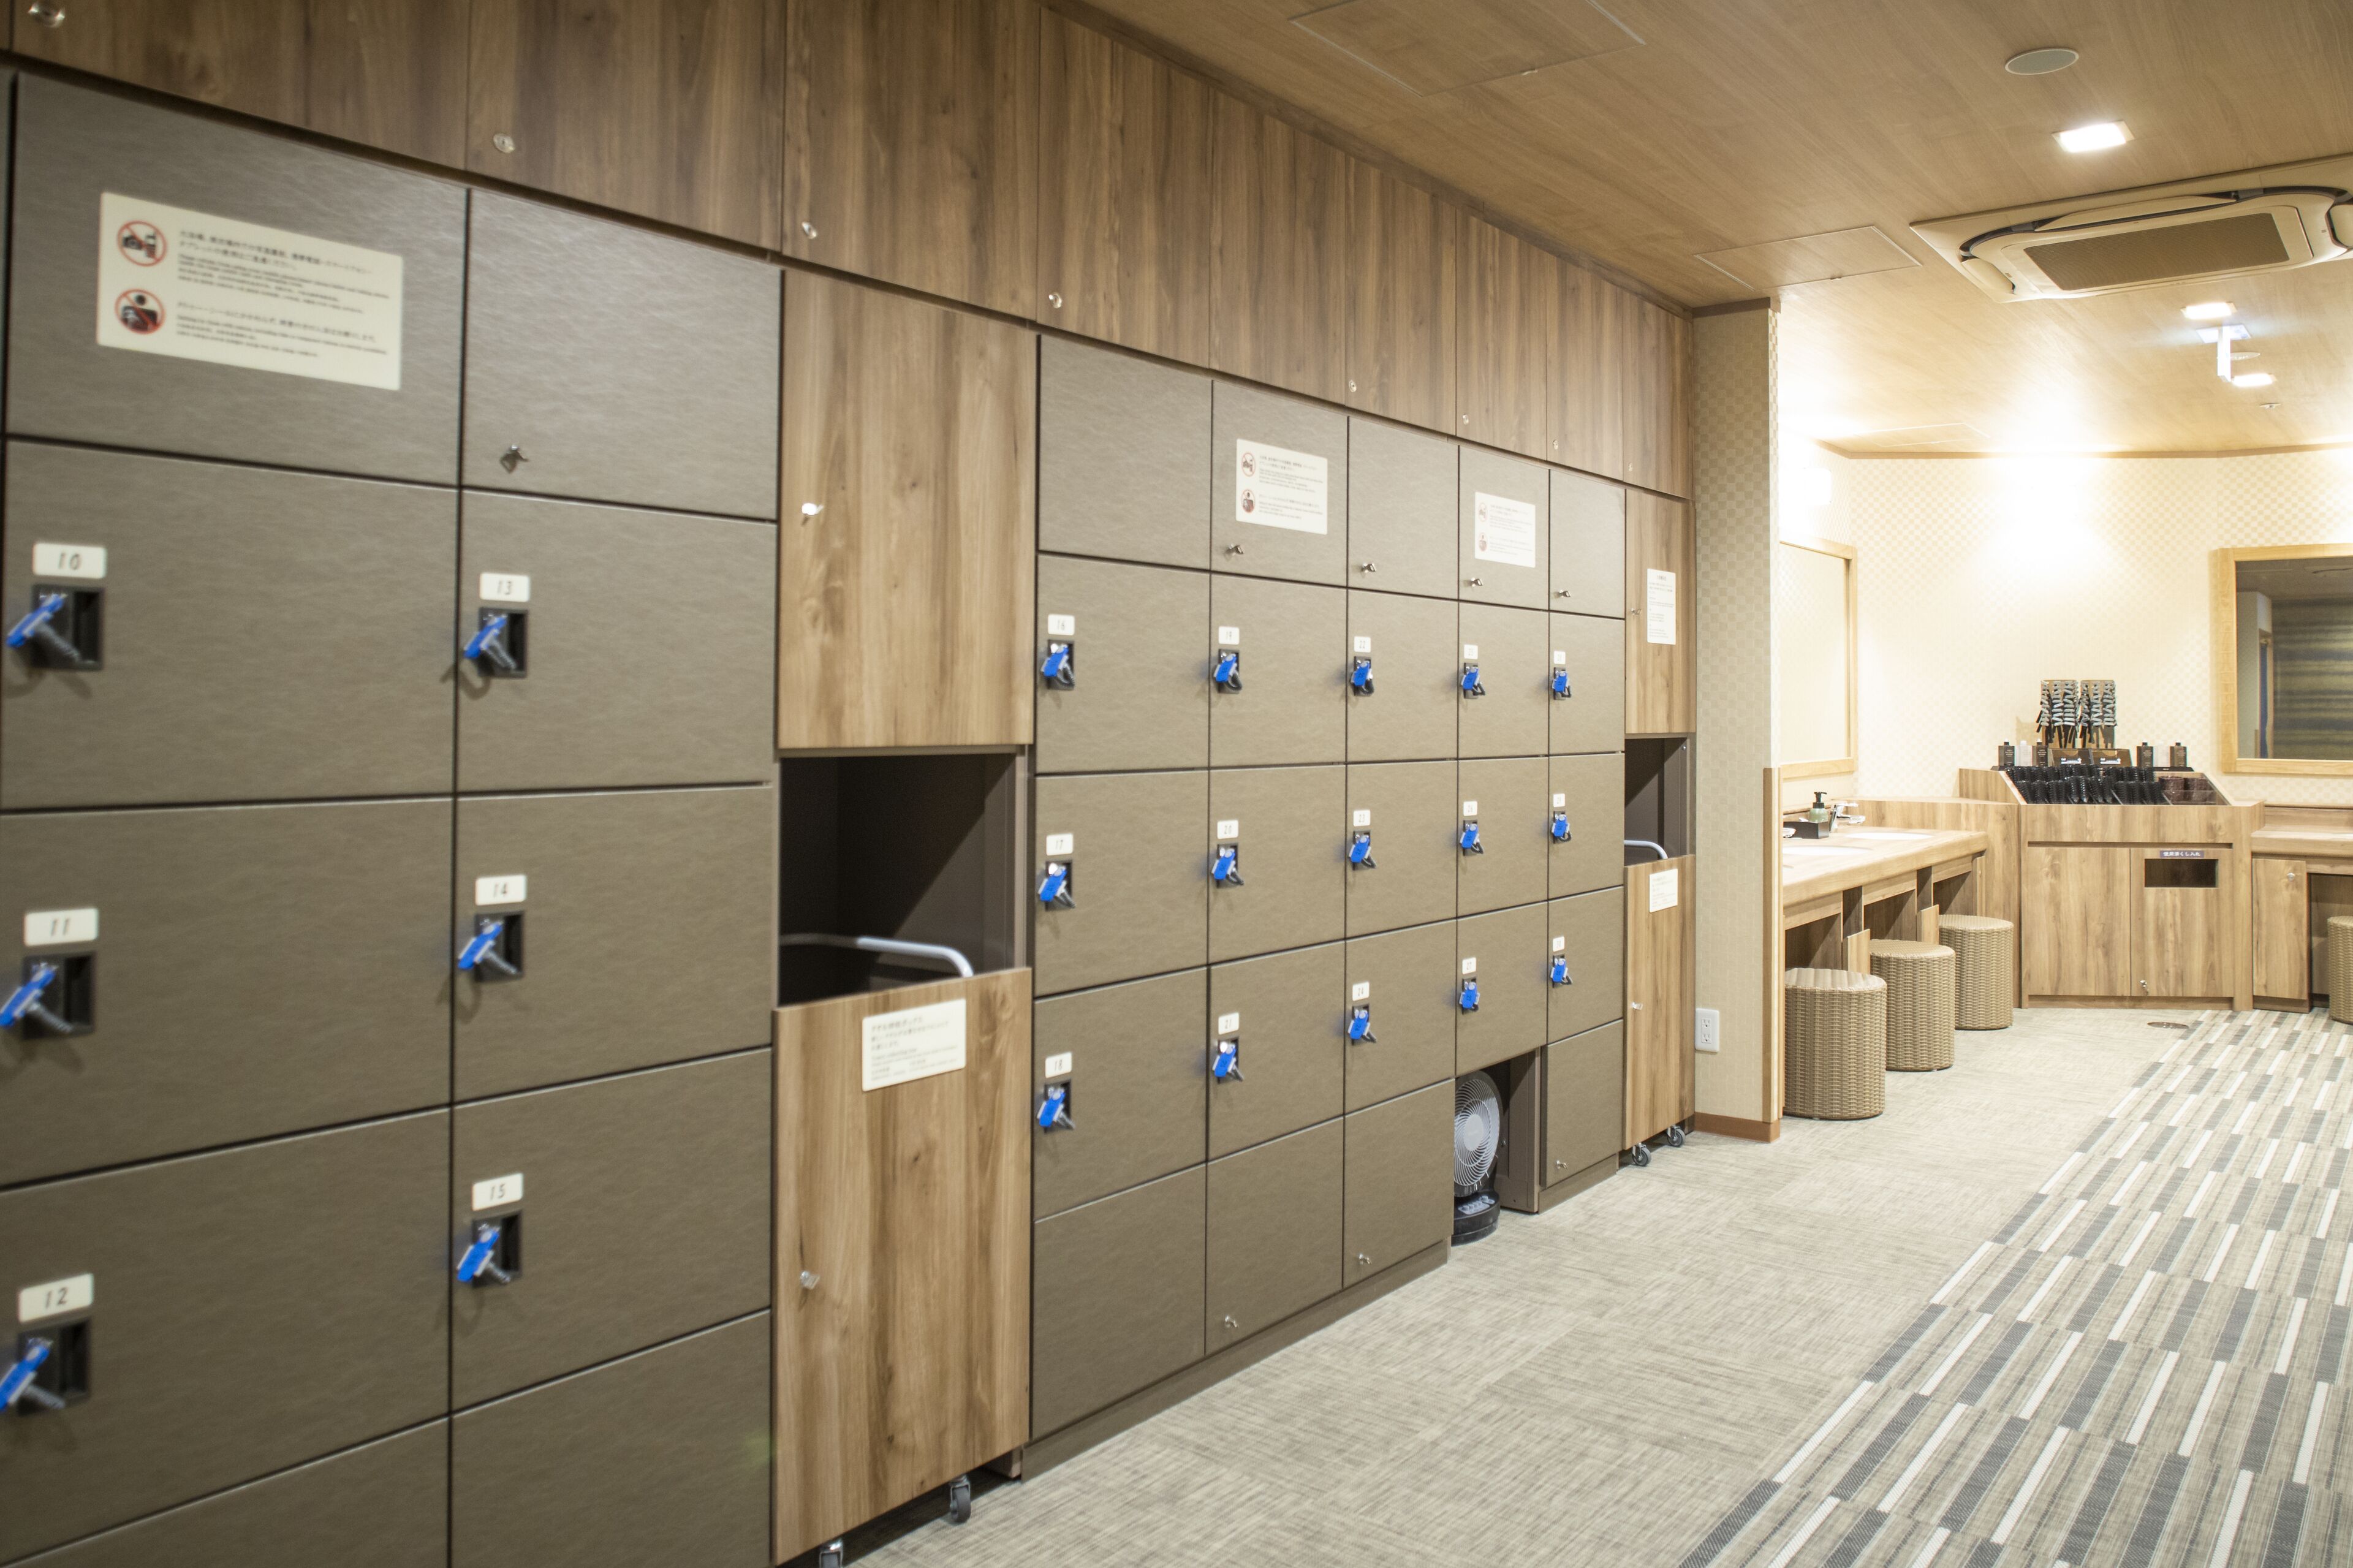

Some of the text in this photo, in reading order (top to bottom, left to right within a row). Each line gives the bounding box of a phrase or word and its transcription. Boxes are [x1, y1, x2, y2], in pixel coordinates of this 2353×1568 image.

[58, 552, 81, 571] 10
[497, 579, 512, 596] 13
[493, 882, 508, 898] 14
[51, 918, 71, 937] 11
[490, 1182, 505, 1200] 15
[45, 1286, 68, 1309] 12
